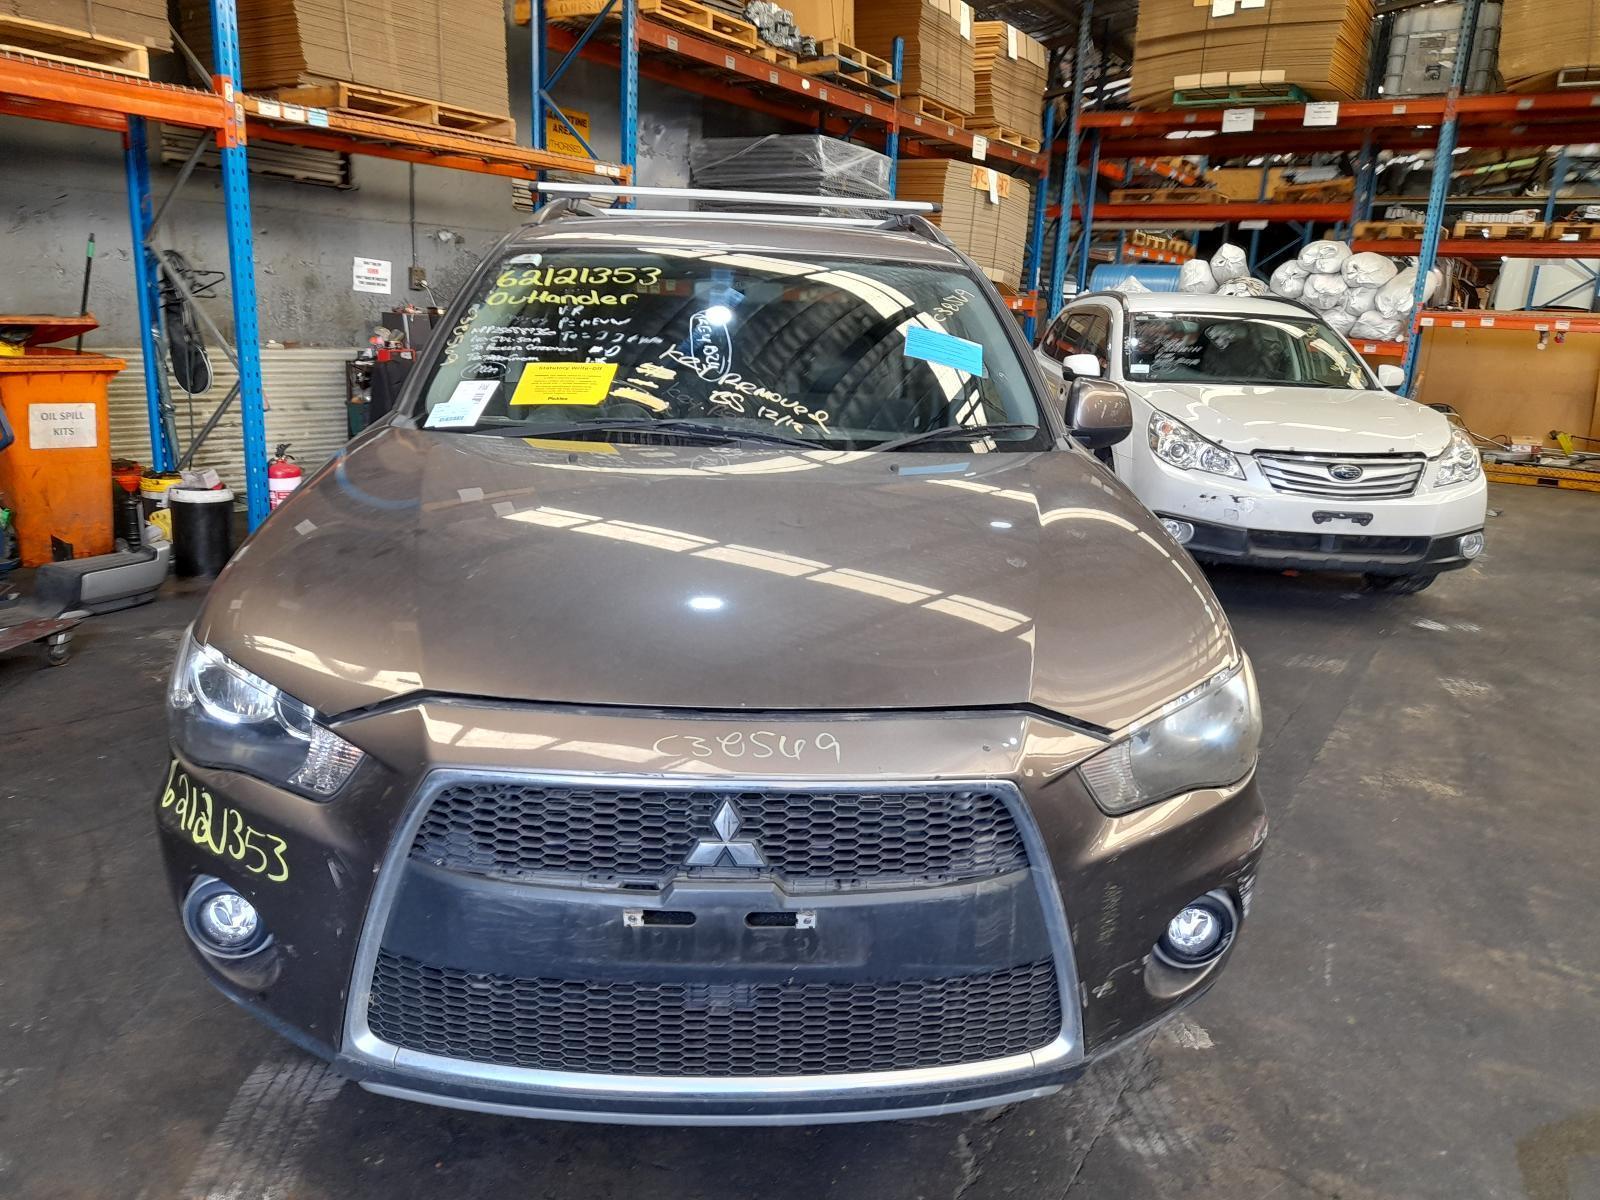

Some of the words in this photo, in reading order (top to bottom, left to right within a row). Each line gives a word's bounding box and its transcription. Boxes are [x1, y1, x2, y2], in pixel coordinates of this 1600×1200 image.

[496, 267, 662, 287] 62121353
[40, 412, 58, 421] OIL
[60, 411, 86, 421] SPILL
[53, 427, 75, 436] KITS
